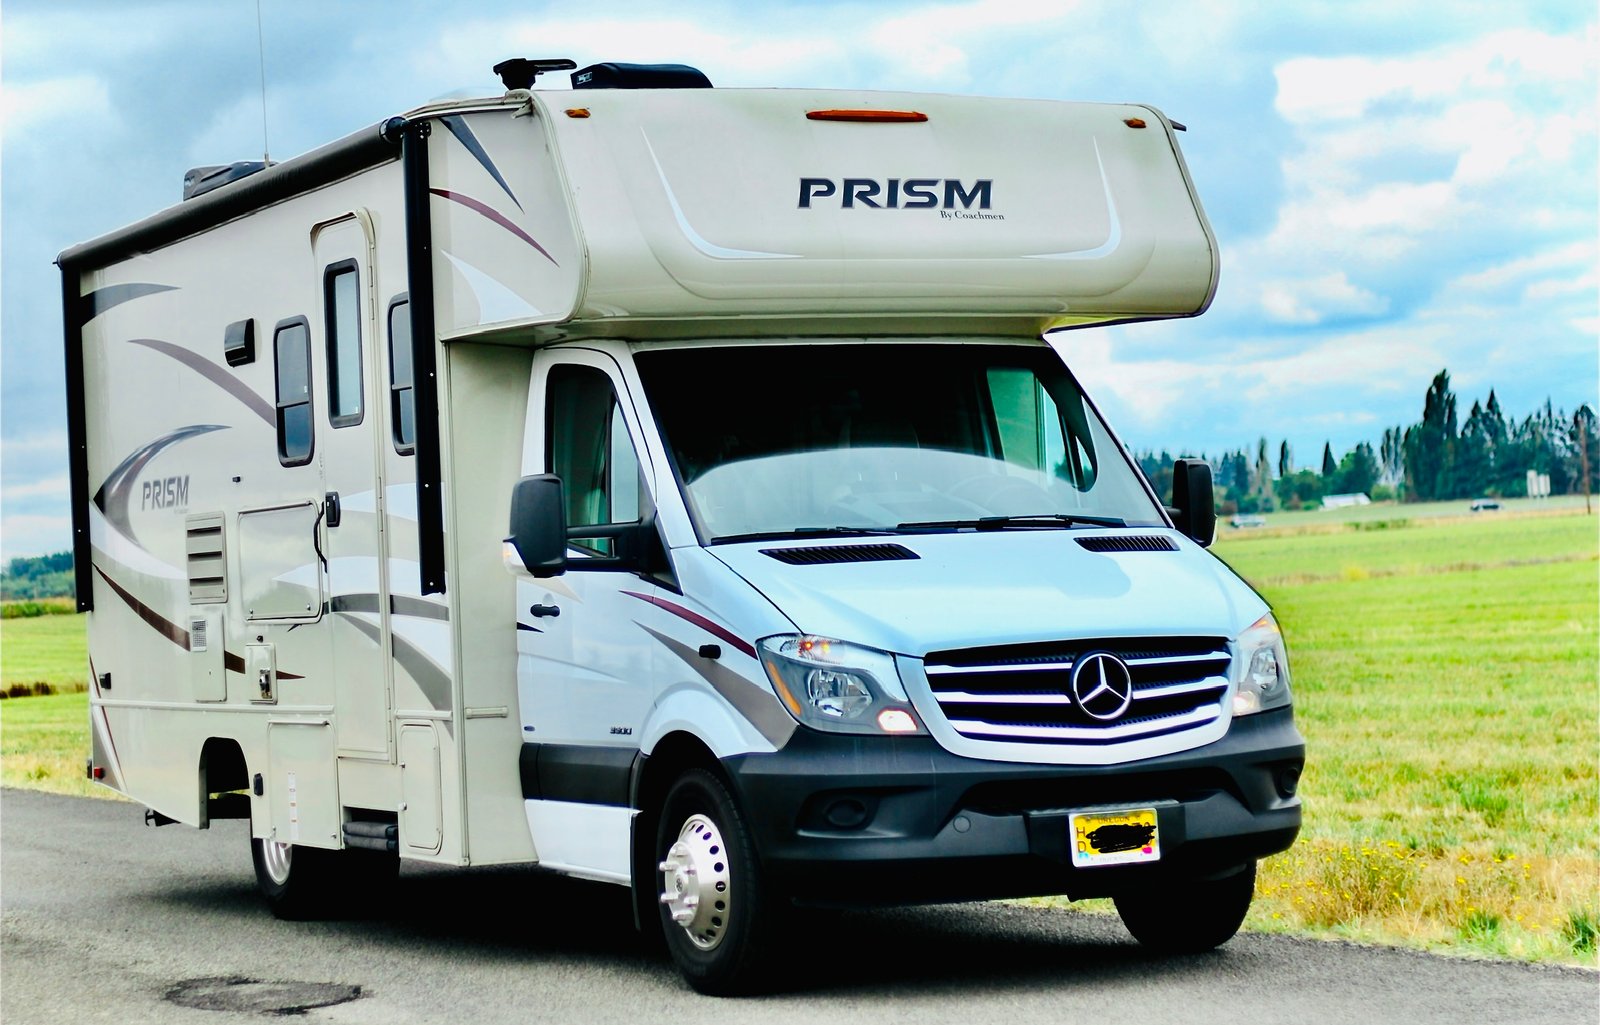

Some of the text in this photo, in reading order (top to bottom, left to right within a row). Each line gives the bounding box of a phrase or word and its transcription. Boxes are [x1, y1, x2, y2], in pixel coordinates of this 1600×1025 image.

[797, 178, 993, 209] PRISM
[940, 210, 1005, 221] By Coachmen
[142, 475, 190, 511] PRISM
